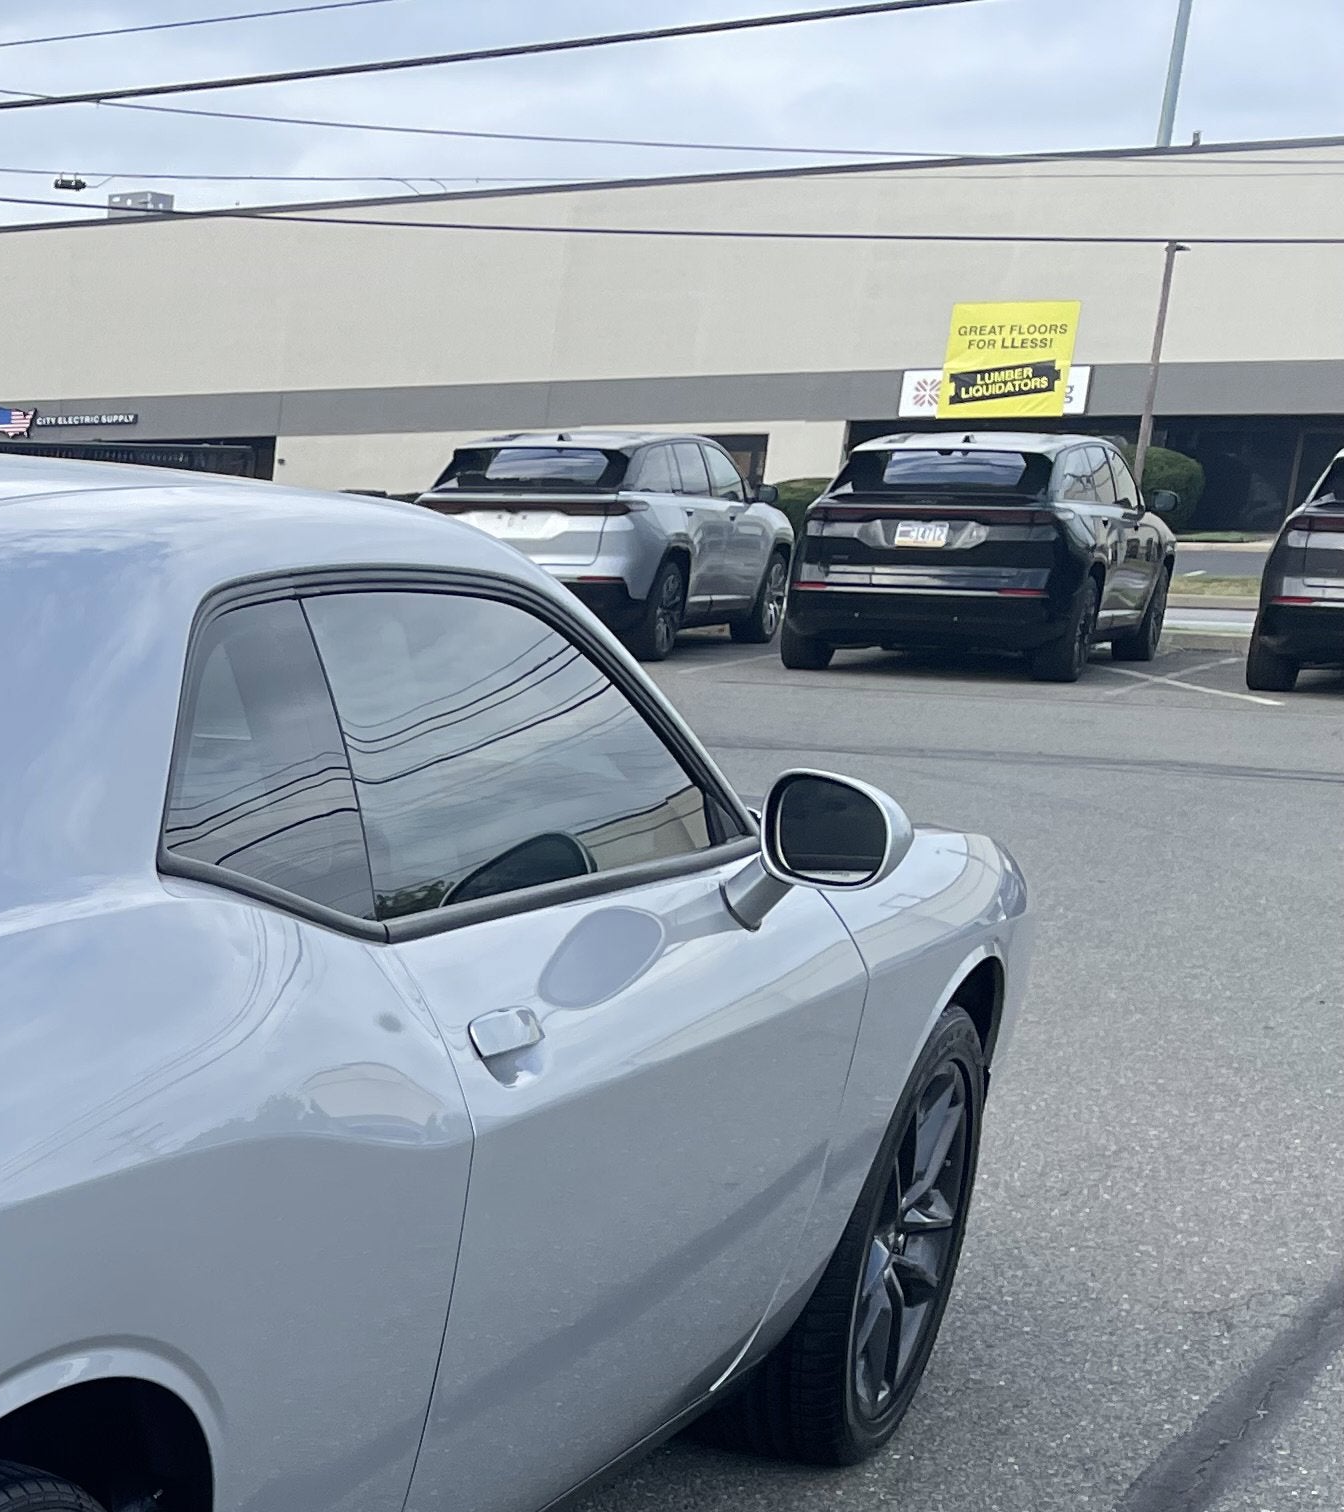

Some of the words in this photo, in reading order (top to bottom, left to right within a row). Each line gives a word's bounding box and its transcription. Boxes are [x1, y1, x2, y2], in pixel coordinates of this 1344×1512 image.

[958, 325, 1006, 336] GREAT
[1009, 323, 1068, 335] FLOORS
[967, 339, 996, 350] FOR
[1001, 337, 1053, 349] LLESS!
[976, 367, 1033, 385] LUMBER
[961, 376, 1049, 399] LIQUIDATORS
[36, 416, 56, 426] CITY
[57, 415, 100, 425] ELECTRIC
[101, 414, 134, 424] SUPPLY
